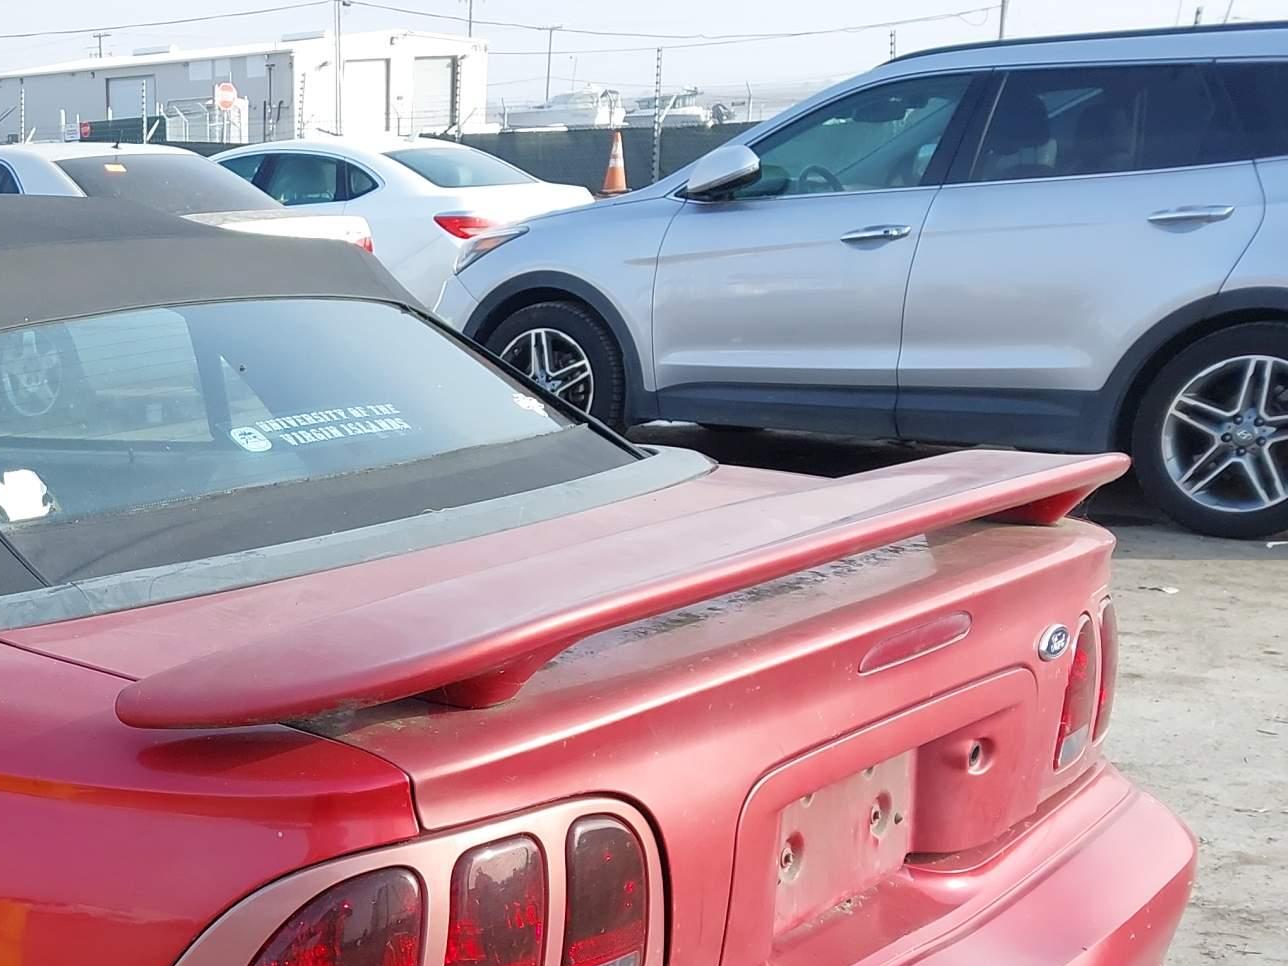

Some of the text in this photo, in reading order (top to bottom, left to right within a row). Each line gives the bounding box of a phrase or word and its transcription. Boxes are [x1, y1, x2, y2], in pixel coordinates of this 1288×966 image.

[255, 403, 401, 433] UNIVERSITY OF THE
[279, 417, 412, 446] VIRGIN ISLANDS
